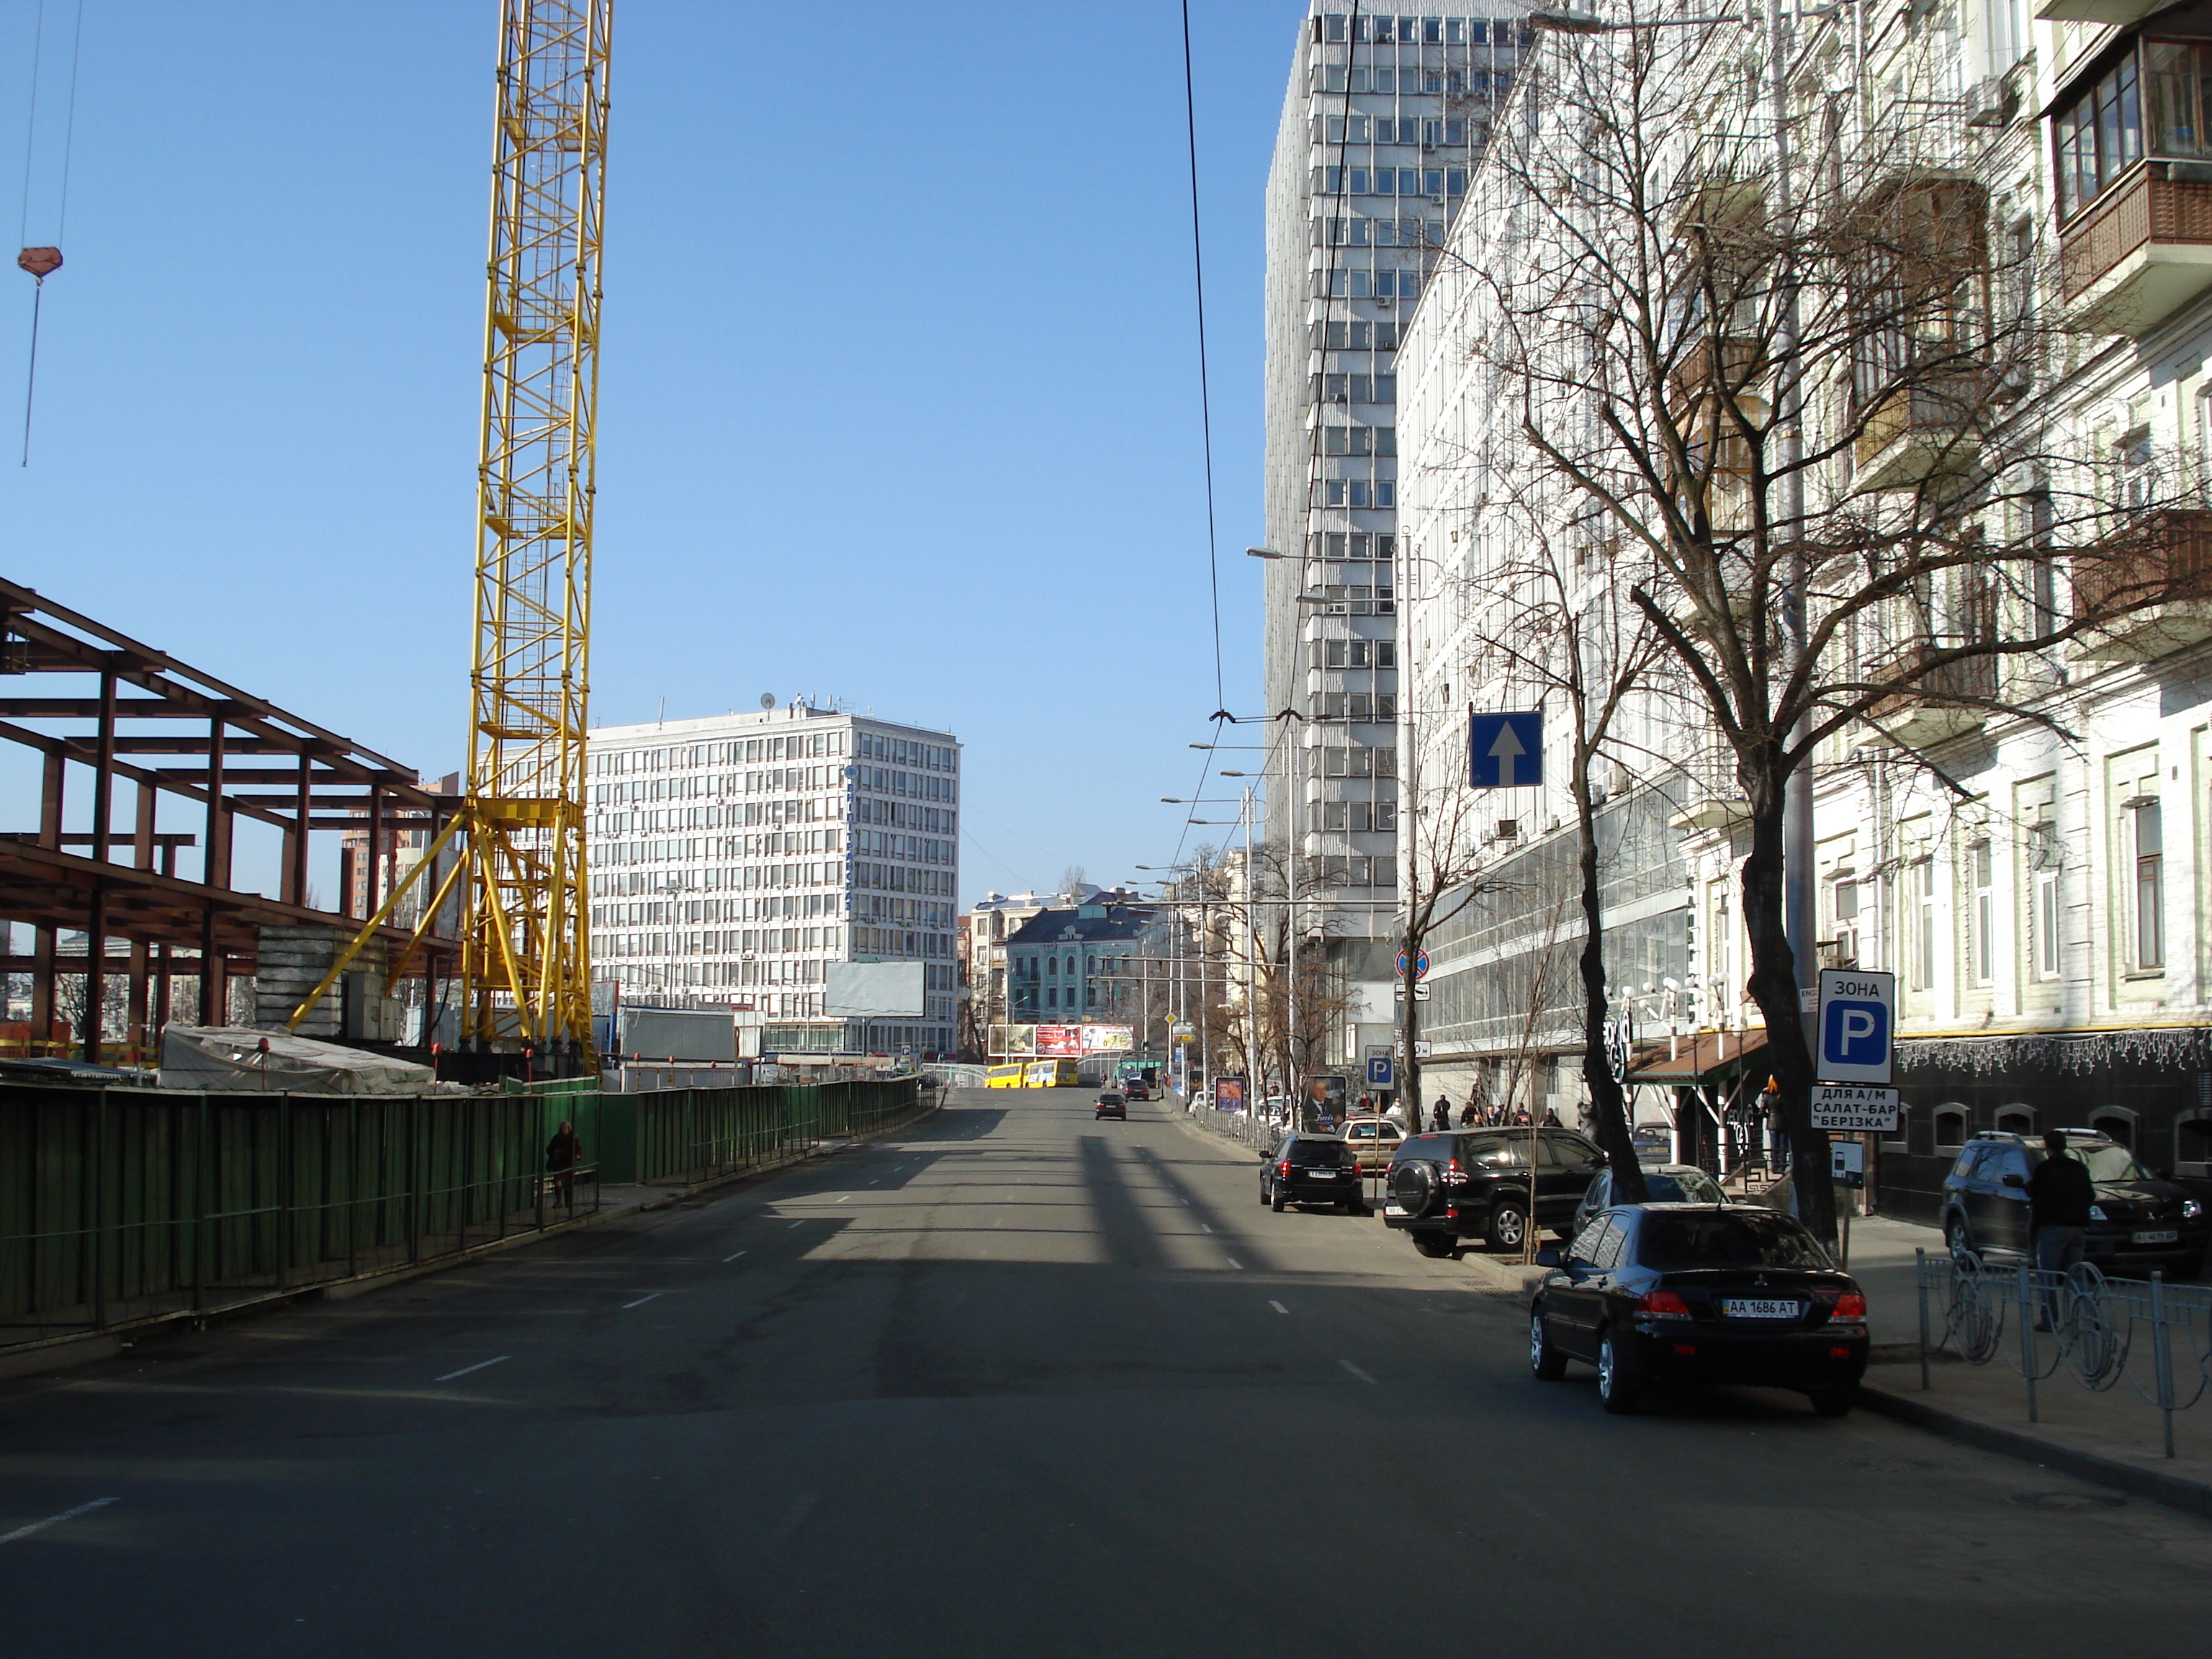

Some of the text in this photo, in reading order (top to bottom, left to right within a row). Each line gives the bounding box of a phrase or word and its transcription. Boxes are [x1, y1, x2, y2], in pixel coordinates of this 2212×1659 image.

[1834, 981, 1879, 997] ЗОНА
[1840, 1009, 1875, 1056] P
[1400, 1044, 1421, 1053] 20
[1373, 1061, 1388, 1080] P
[1822, 1089, 1886, 1101] ДЛЯ А/М
[1813, 1103, 1897, 1115] САЛАТ-БАР
[1730, 1300, 1796, 1313] AA 1686 AT
